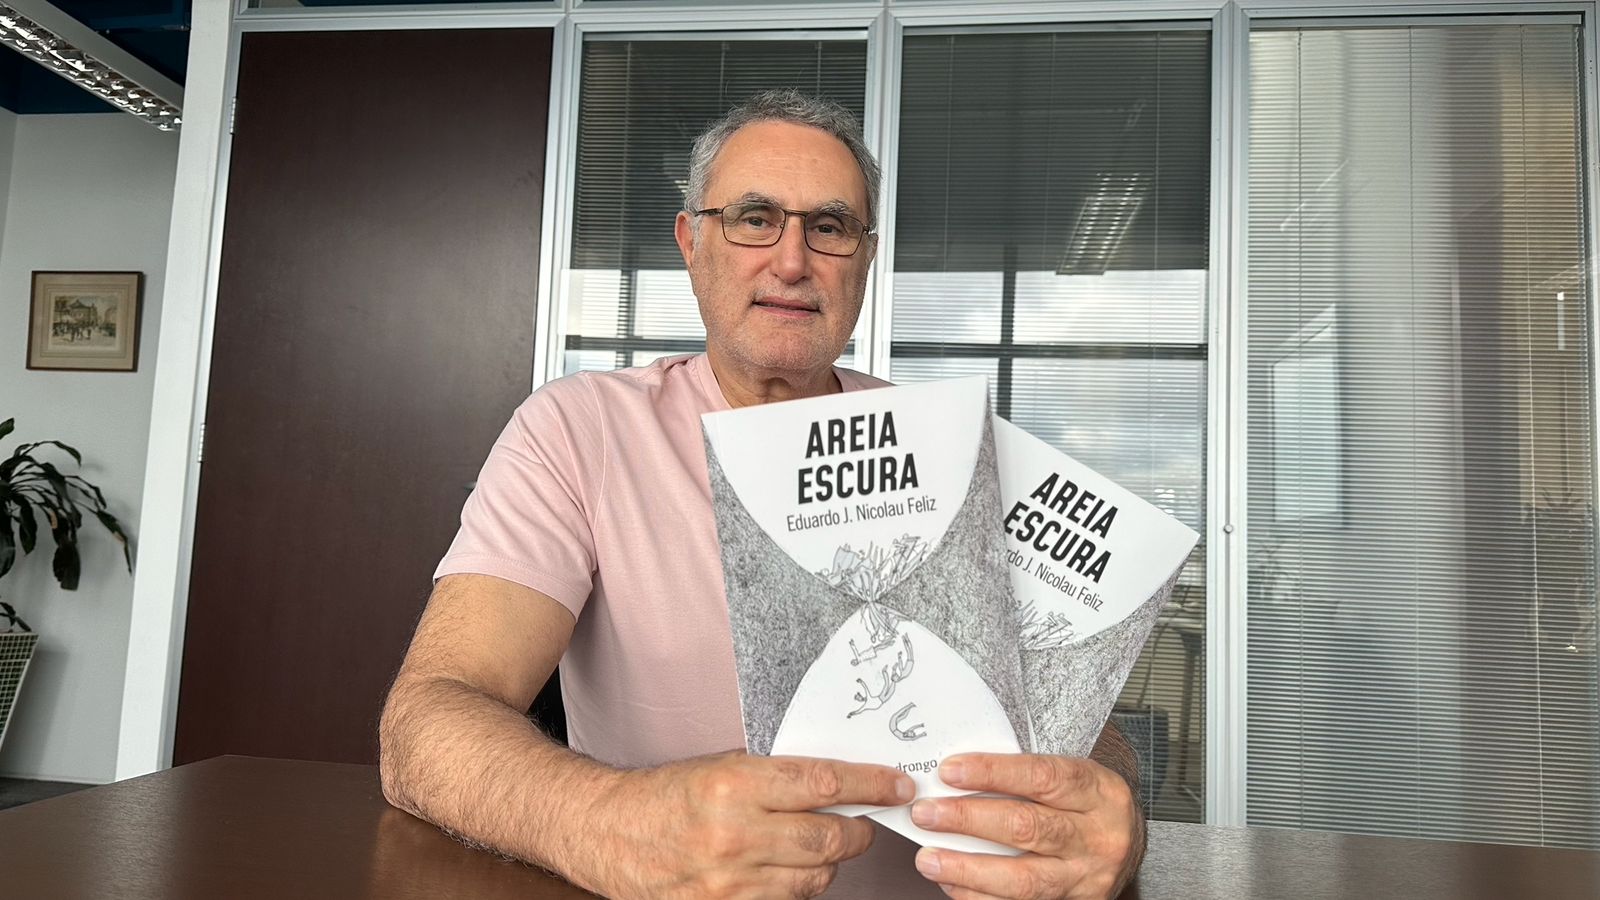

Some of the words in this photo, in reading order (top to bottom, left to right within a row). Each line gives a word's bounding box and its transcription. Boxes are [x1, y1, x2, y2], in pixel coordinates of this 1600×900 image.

[804, 410, 898, 460] AREIA
[797, 452, 920, 506] ESCURA
[1028, 471, 1119, 540] AREIA
[786, 509, 841, 532] Eduardo
[843, 506, 853, 524] J.
[855, 500, 905, 521] Nicolau
[907, 495, 937, 515] Feliz
[1003, 500, 1112, 584] ESCURA
[1022, 556, 1034, 573] J.
[1034, 562, 1077, 597] Nicolau
[1077, 586, 1104, 612] Feliz
